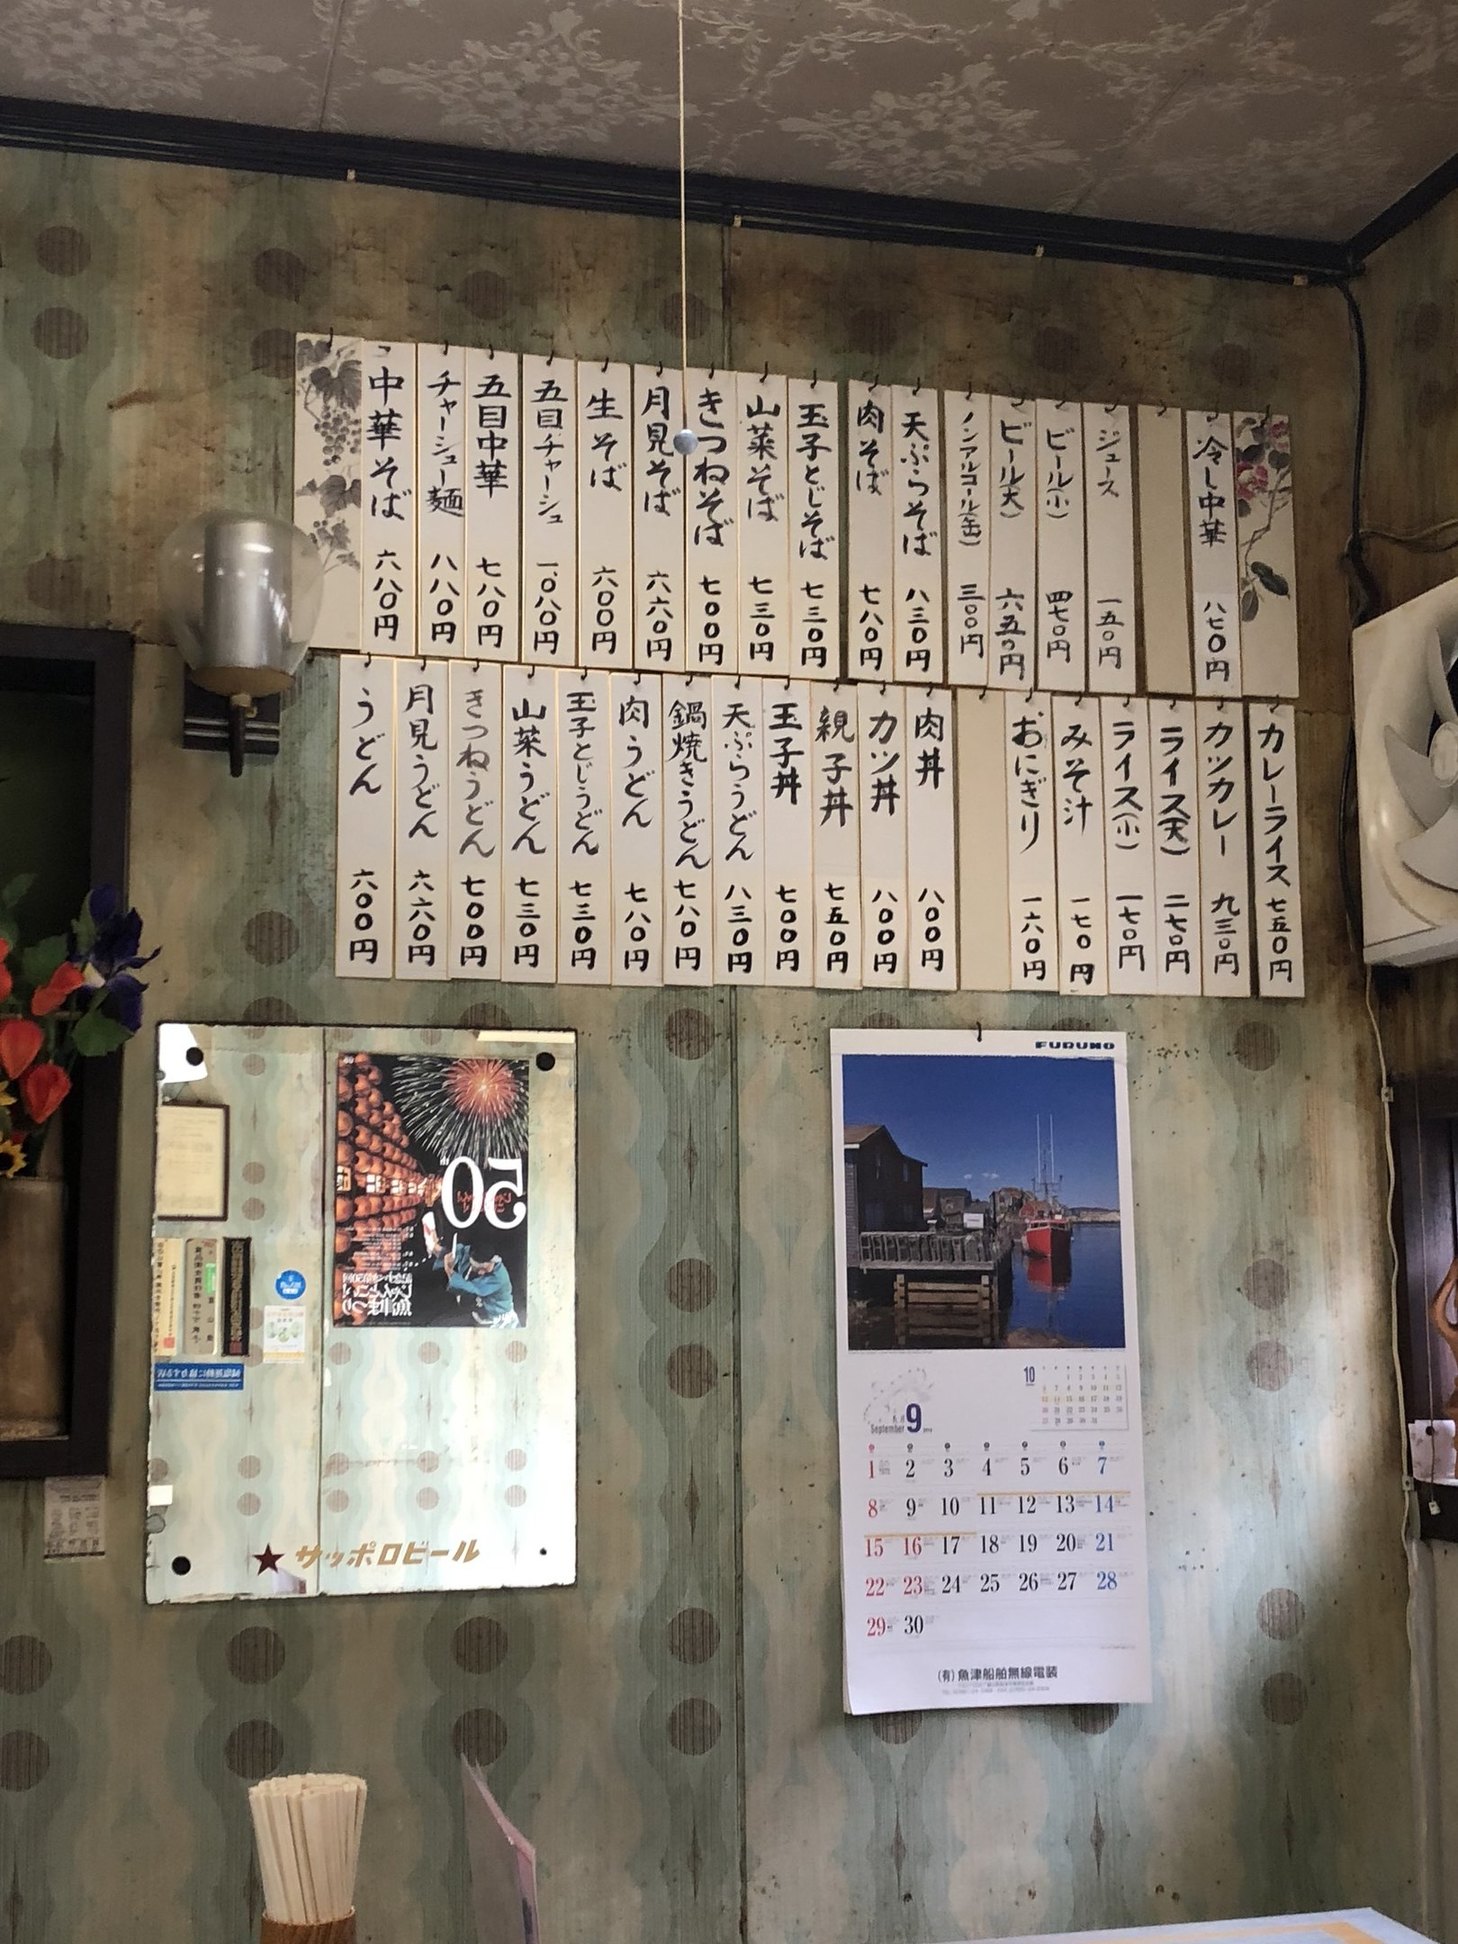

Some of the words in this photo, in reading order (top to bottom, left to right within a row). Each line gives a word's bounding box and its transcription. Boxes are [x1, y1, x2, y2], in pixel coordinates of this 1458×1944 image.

[367, 366, 411, 520] 中華そば
[427, 370, 464, 517] チャーシュー麺
[473, 374, 511, 498] 五目中華
[587, 388, 626, 491] 生そば
[641, 386, 682, 516] 月見そば
[693, 388, 733, 546] きつねそば
[857, 400, 889, 495] 肉そば
[1096, 430, 1120, 497] ジュース
[796, 404, 834, 560] 玉子とじそば
[901, 412, 939, 556] 天ぷらそば
[1193, 436, 1228, 547] 冷し中華
[374, 550, 403, 641] 六八〇円
[430, 554, 459, 644] 八八〇円
[477, 558, 505, 648] 七八〇円
[592, 567, 618, 654] 六〇〇円
[647, 572, 673, 661] 六六〇円
[699, 576, 723, 665] 七〇〇円
[749, 576, 775, 661] 七三〇円
[801, 582, 827, 668] 七三〇円
[860, 584, 883, 671] 七八〇円
[906, 589, 930, 672] 八三〇円
[958, 584, 985, 658] 三〇〇円
[995, 588, 1026, 680] 六五〇円
[1046, 591, 1073, 663] 四七〇円
[1096, 599, 1124, 669] 一五〇円
[1204, 602, 1229, 681] 八七〇円
[349, 688, 385, 795] うどん
[406, 685, 439, 838] 月見うどん
[457, 689, 495, 858] きつねうどん
[567, 692, 602, 855] 玉子とじうどん
[619, 699, 654, 827] 肉うどん
[669, 700, 710, 869] 鍋焼きうどん
[723, 703, 756, 861] 天ぷらうどん
[769, 703, 804, 805] 玉子丼
[815, 706, 855, 827] 親子丼
[870, 711, 900, 816] カツ丼
[915, 707, 945, 789] 肉丼
[1012, 712, 1046, 852] おにぎり
[1061, 725, 1093, 832] みそ汁
[1204, 722, 1237, 856] カツカレー
[1258, 723, 1290, 887] カレーライス
[350, 869, 378, 964] 六〇〇円
[408, 870, 435, 966] 六六〇円
[461, 876, 487, 967] 七〇〇円
[514, 877, 540, 968] 七三〇円
[570, 881, 596, 970] 七三〇円
[625, 883, 651, 972] 七八〇円
[674, 880, 700, 971] 七八〇円
[725, 885, 752, 973] 八三〇円
[776, 885, 799, 972] 七〇〇円
[825, 883, 849, 973] 七五〇円
[872, 890, 897, 973] 八〇〇円
[918, 888, 944, 972] 八〇〇円
[1021, 897, 1045, 980] 一六〇円
[1071, 898, 1094, 985] 一七〇円
[1116, 895, 1145, 971] 一七〇円
[1164, 895, 1190, 974] 二七〇円
[1211, 893, 1240, 976] 九三〇円
[1266, 898, 1292, 982] 七五〇円
[1035, 1041, 1115, 1050] FURUNO
[1024, 1366, 1035, 1382] 10
[871, 1424, 904, 1435] September
[906, 1403, 921, 1433] 9
[868, 1499, 878, 1518] 8
[906, 1498, 916, 1517] 9
[941, 1497, 959, 1516] 10
[980, 1497, 995, 1515] 11
[1019, 1496, 1036, 1514] 12
[1057, 1495, 1075, 1513] 13
[1096, 1494, 1113, 1512] 14
[869, 1460, 874, 1478] 1
[906, 1459, 915, 1478] 2
[944, 1459, 953, 1477] 3
[982, 1458, 991, 1476] 4
[1021, 1458, 1030, 1476] 5
[1059, 1457, 1068, 1475] 6
[1097, 1457, 1107, 1475] 7
[295, 1540, 479, 1569] サッポロビール
[865, 1537, 883, 1557] 15
[903, 1536, 922, 1556] 16
[942, 1536, 960, 1554] 17
[981, 1535, 999, 1554] 18
[1019, 1534, 1037, 1552] 19
[1056, 1534, 1076, 1552] 20
[1096, 1533, 1113, 1551] 21
[866, 1578, 884, 1596] 22
[904, 1576, 922, 1596] 23
[942, 1576, 960, 1594] 24
[980, 1574, 999, 1592] 25
[1019, 1573, 1038, 1591] 26
[1058, 1572, 1076, 1590] 27
[1097, 1571, 1117, 1590] 28
[867, 1618, 885, 1636] 29
[904, 1615, 923, 1634] 30
